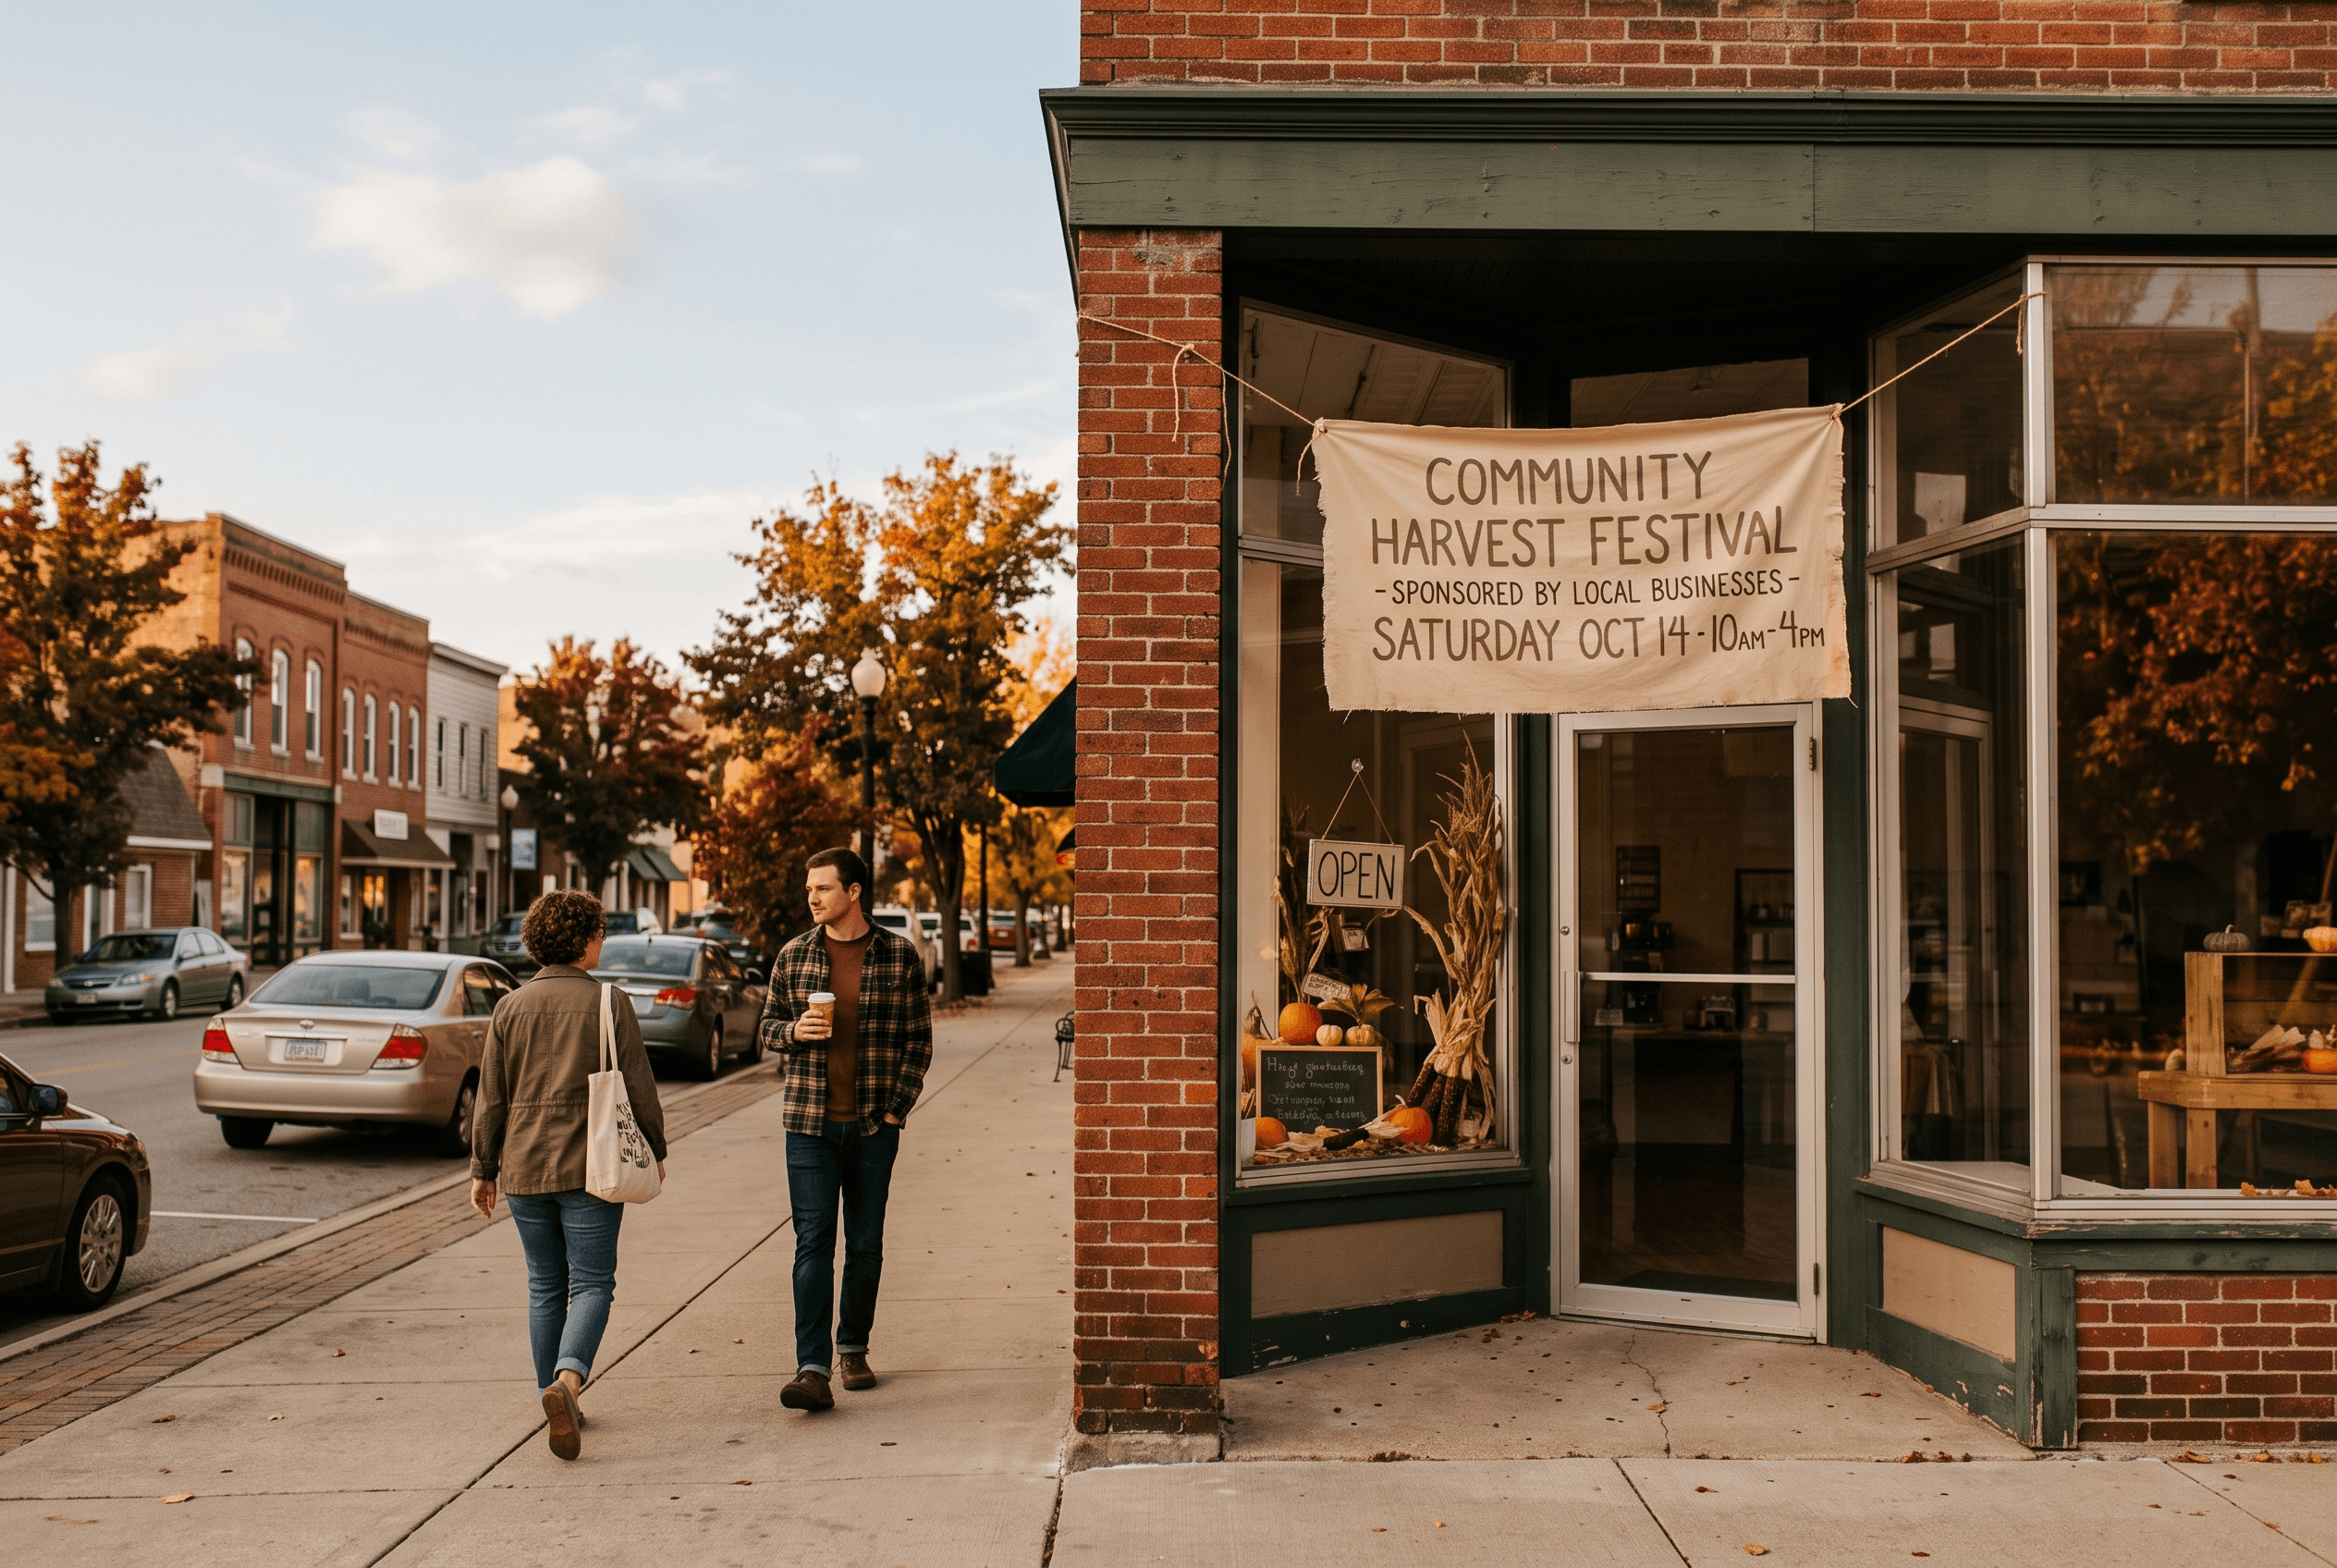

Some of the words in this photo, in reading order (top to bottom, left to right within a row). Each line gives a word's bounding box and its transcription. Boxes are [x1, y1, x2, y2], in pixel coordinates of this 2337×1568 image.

[1425, 450, 1713, 507] COMMUNITY
[1371, 518, 1566, 569] HARVEST
[1589, 505, 1798, 568] FESTIVAL
[1535, 580, 1562, 606] BY
[1572, 579, 1642, 606] LOCAL
[1372, 616, 1560, 662] SATURDAY
[1578, 617, 1646, 660] OCT
[1317, 851, 1396, 900] OPEN
